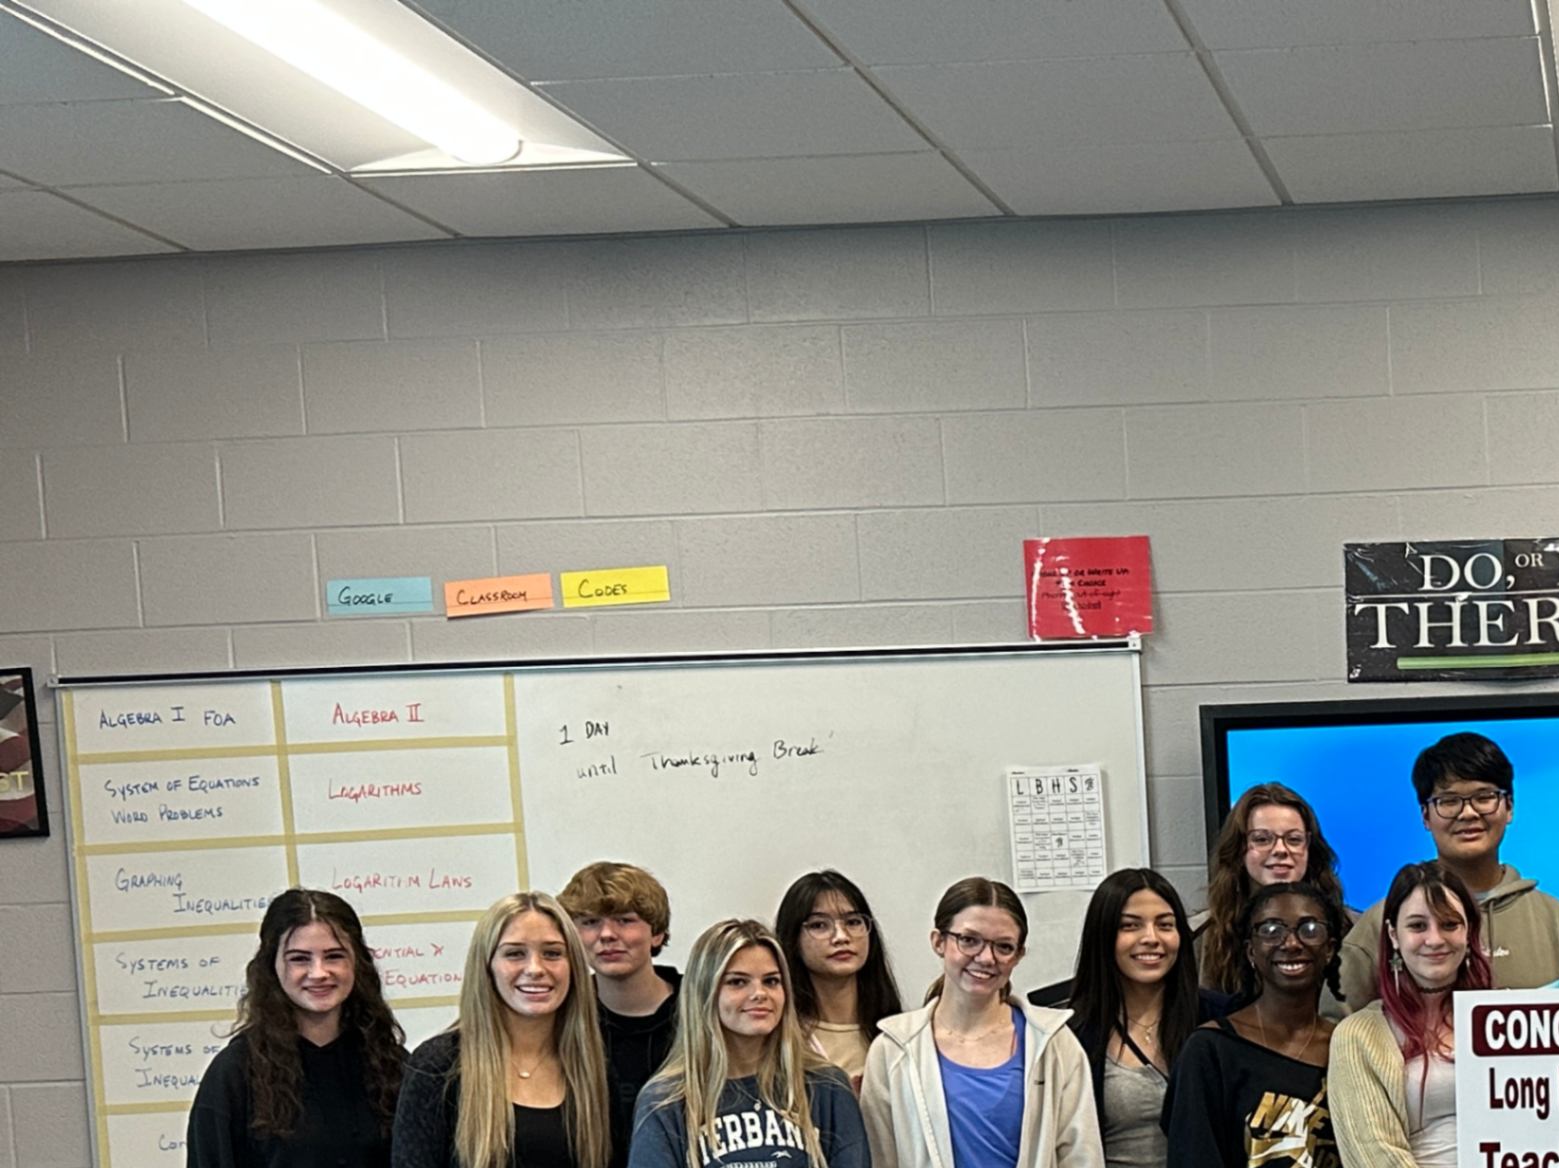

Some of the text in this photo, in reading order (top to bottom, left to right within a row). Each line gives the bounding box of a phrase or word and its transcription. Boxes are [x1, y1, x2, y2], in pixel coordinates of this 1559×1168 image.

[1418, 552, 1516, 592] DO,
[1514, 552, 1544, 568] OR
[338, 579, 628, 606] GOOGLE CLASSROOM CODES
[99, 706, 236, 729] ALGEBRA I FOA
[333, 702, 399, 727] ALGEBRA
[560, 721, 609, 745] 1 DAY
[576, 755, 617, 780] until
[640, 751, 760, 778] Thanksgiving
[188, 775, 260, 794] EQUATIONS
[328, 778, 422, 803] LOGARITHMS
[1035, 779, 1043, 795] B
[1052, 778, 1061, 793] H
[1069, 777, 1078, 793] S
[111, 804, 223, 823] WORD PROBLEMS
[429, 868, 472, 889] LAWS
[199, 957, 220, 968] OF
[142, 980, 249, 999] INEQUALITIE
[1489, 1067, 1551, 1120] Long
[1250, 1092, 1329, 1137] NIKE
